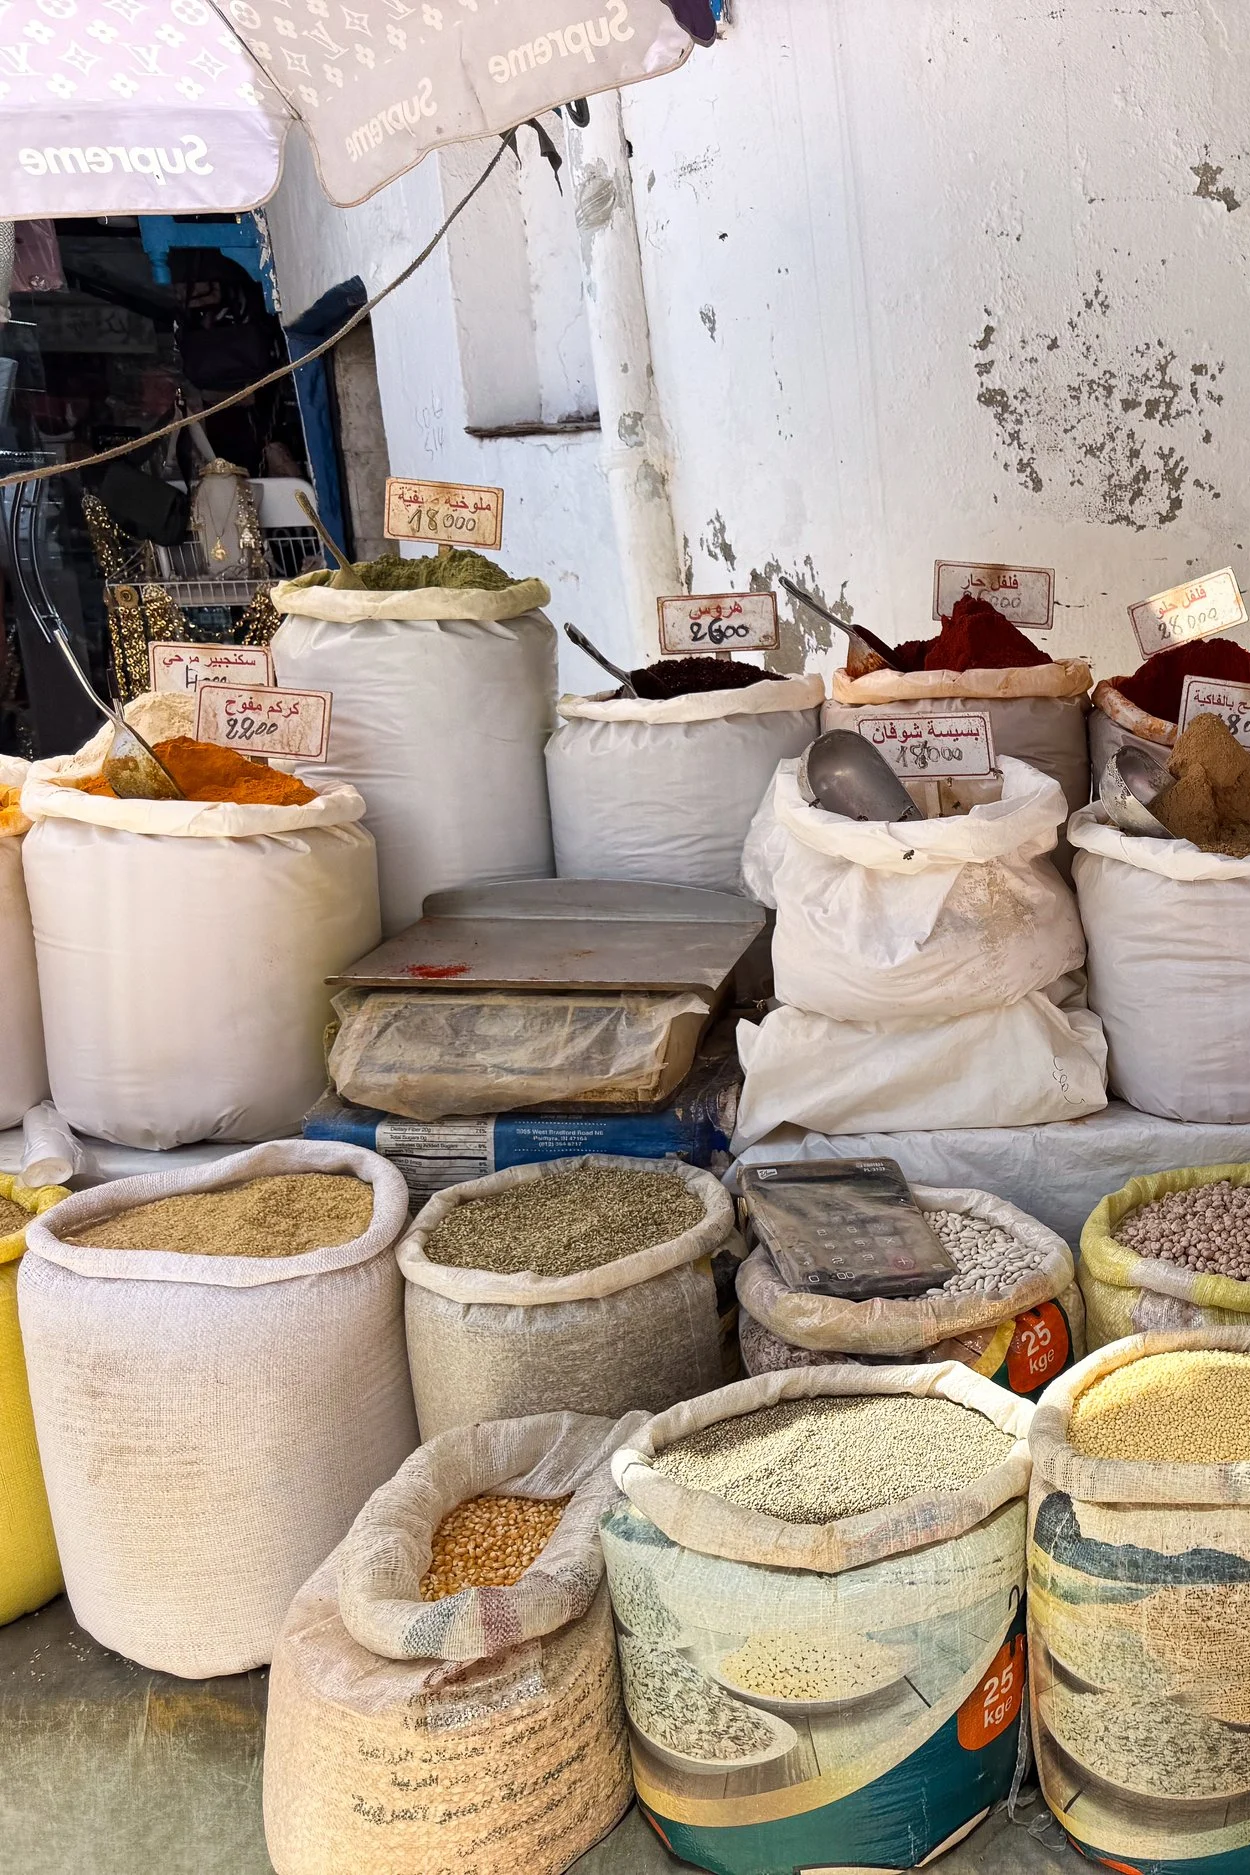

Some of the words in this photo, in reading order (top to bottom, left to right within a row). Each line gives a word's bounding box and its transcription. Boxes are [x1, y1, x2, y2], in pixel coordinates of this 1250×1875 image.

[408, 508, 477, 533] 18000
[961, 573, 986, 590] حار
[991, 574, 1019, 591] فلفل
[1182, 585, 1207, 609] فلفل
[267, 701, 300, 718] كركم
[872, 722, 923, 744] شوفان
[927, 720, 980, 742] بسيسة
[1021, 1320, 1052, 1357] 25
[983, 1662, 1014, 1708] 25
